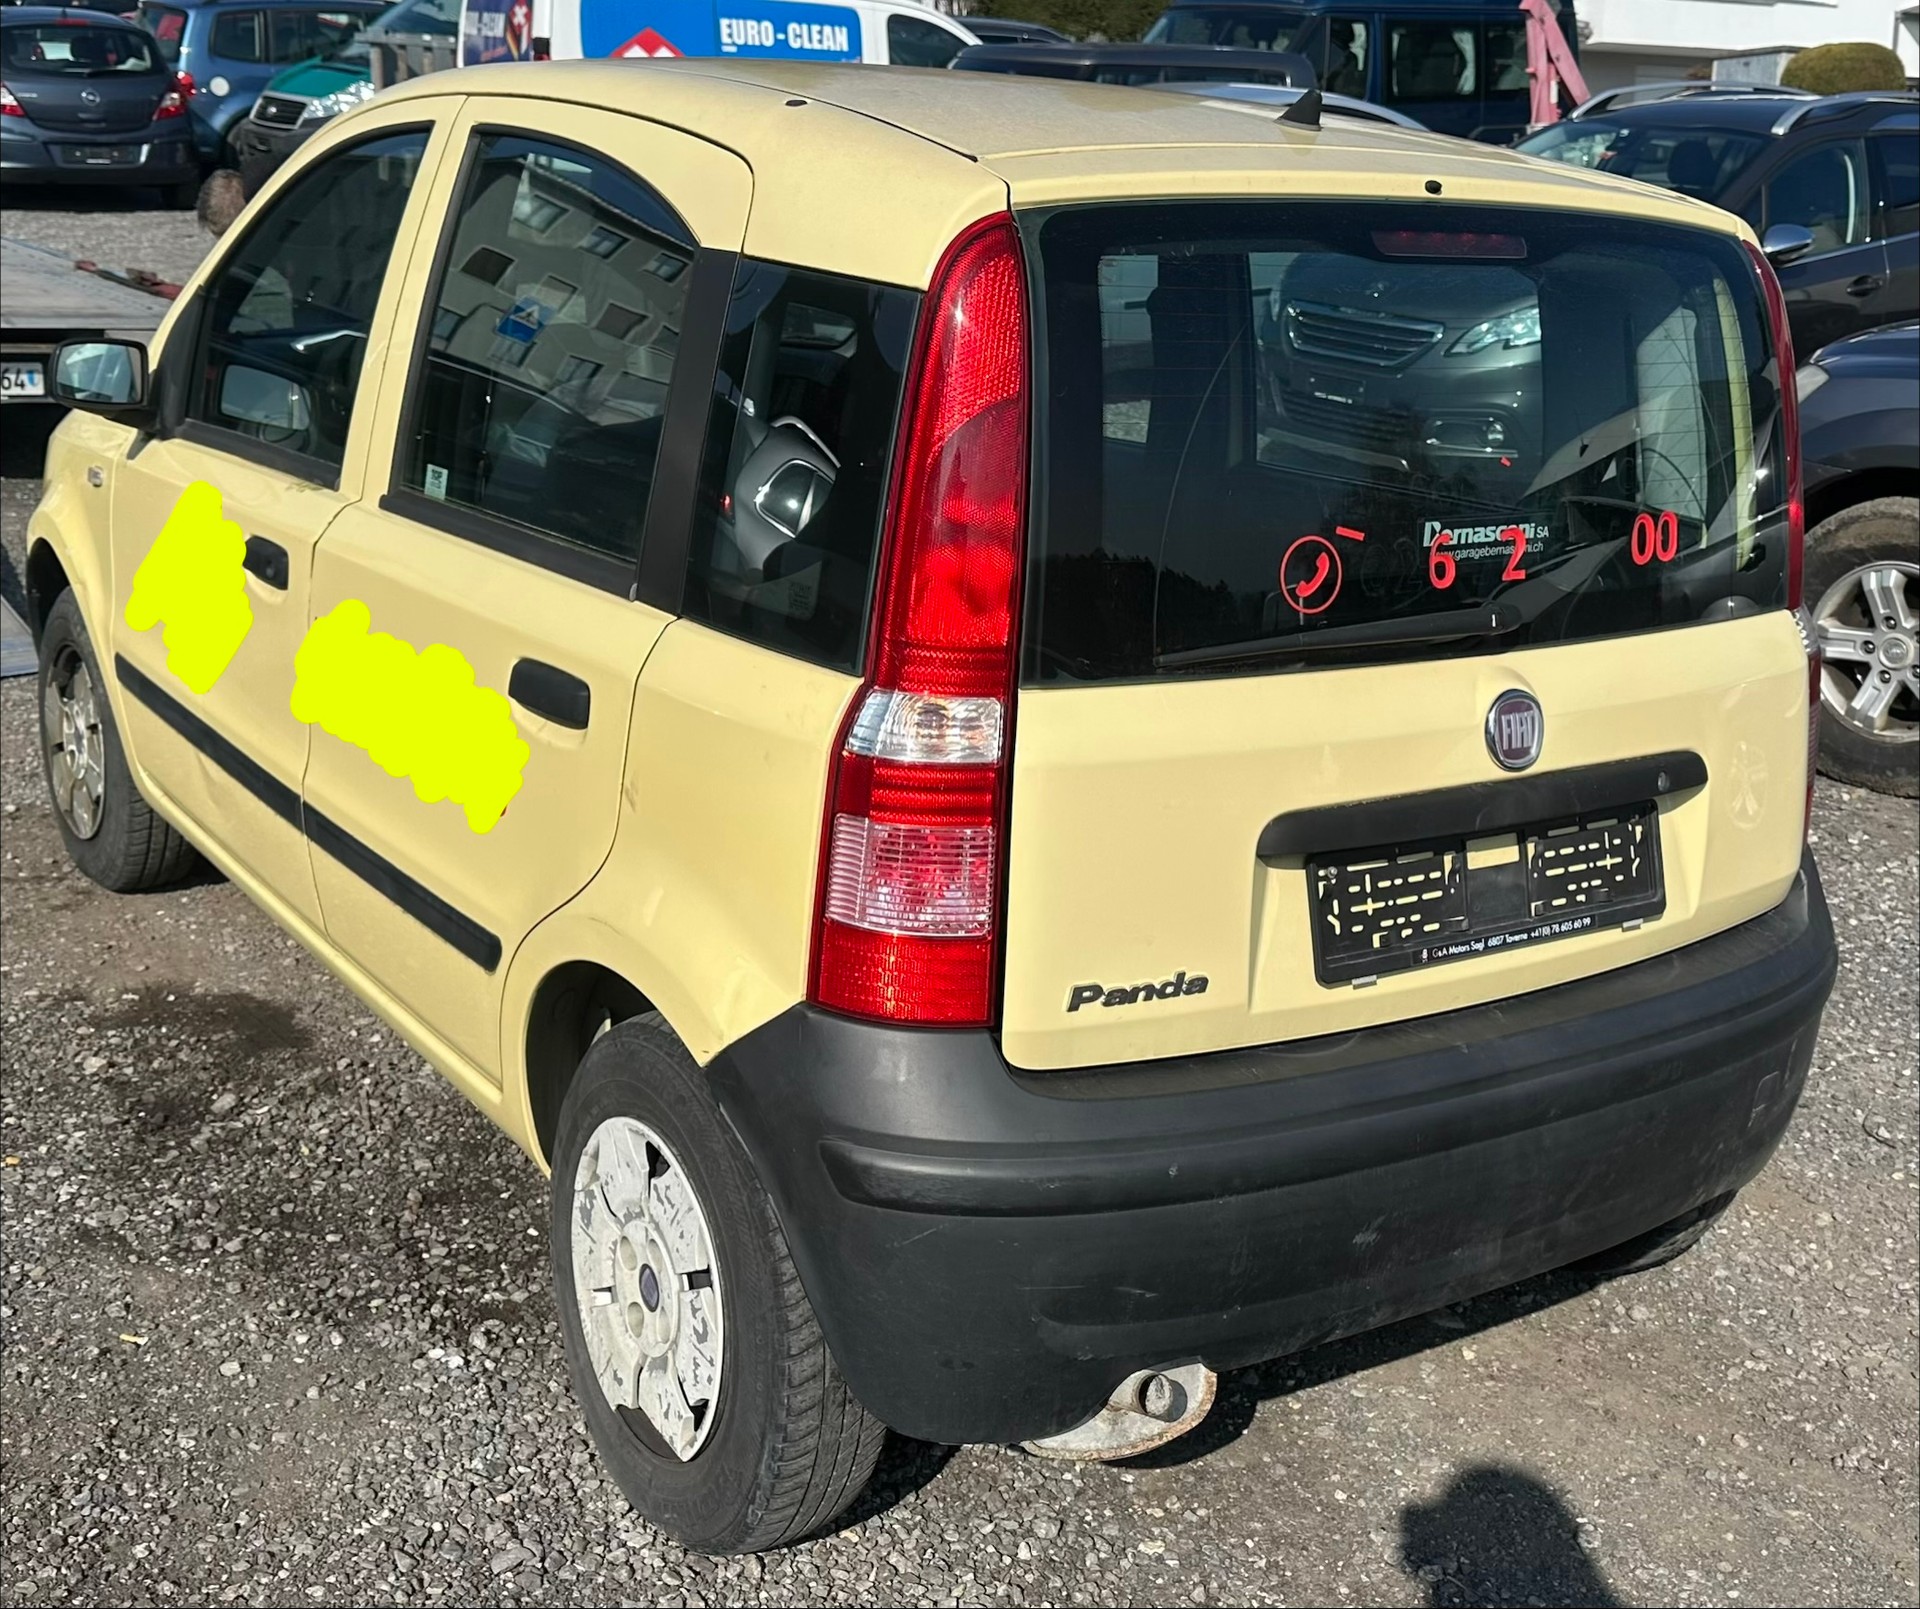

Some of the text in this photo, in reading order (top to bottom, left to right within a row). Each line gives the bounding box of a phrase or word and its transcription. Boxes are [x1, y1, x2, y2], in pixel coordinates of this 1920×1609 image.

[1434, 541, 1544, 561] garagebernasni.ch
[1536, 526, 1549, 538] SA
[1631, 510, 1677, 565] 00
[1501, 710, 1534, 750] FIAT
[1448, 943, 1470, 955] Motors
[1470, 938, 1485, 951] Sagl
[1487, 935, 1504, 947] 6807
[1551, 923, 1560, 934] 78
[1560, 920, 1573, 932] 605
[1573, 918, 1582, 929] 60
[1582, 916, 1591, 927] 99
[1066, 970, 1209, 1012] Panda
